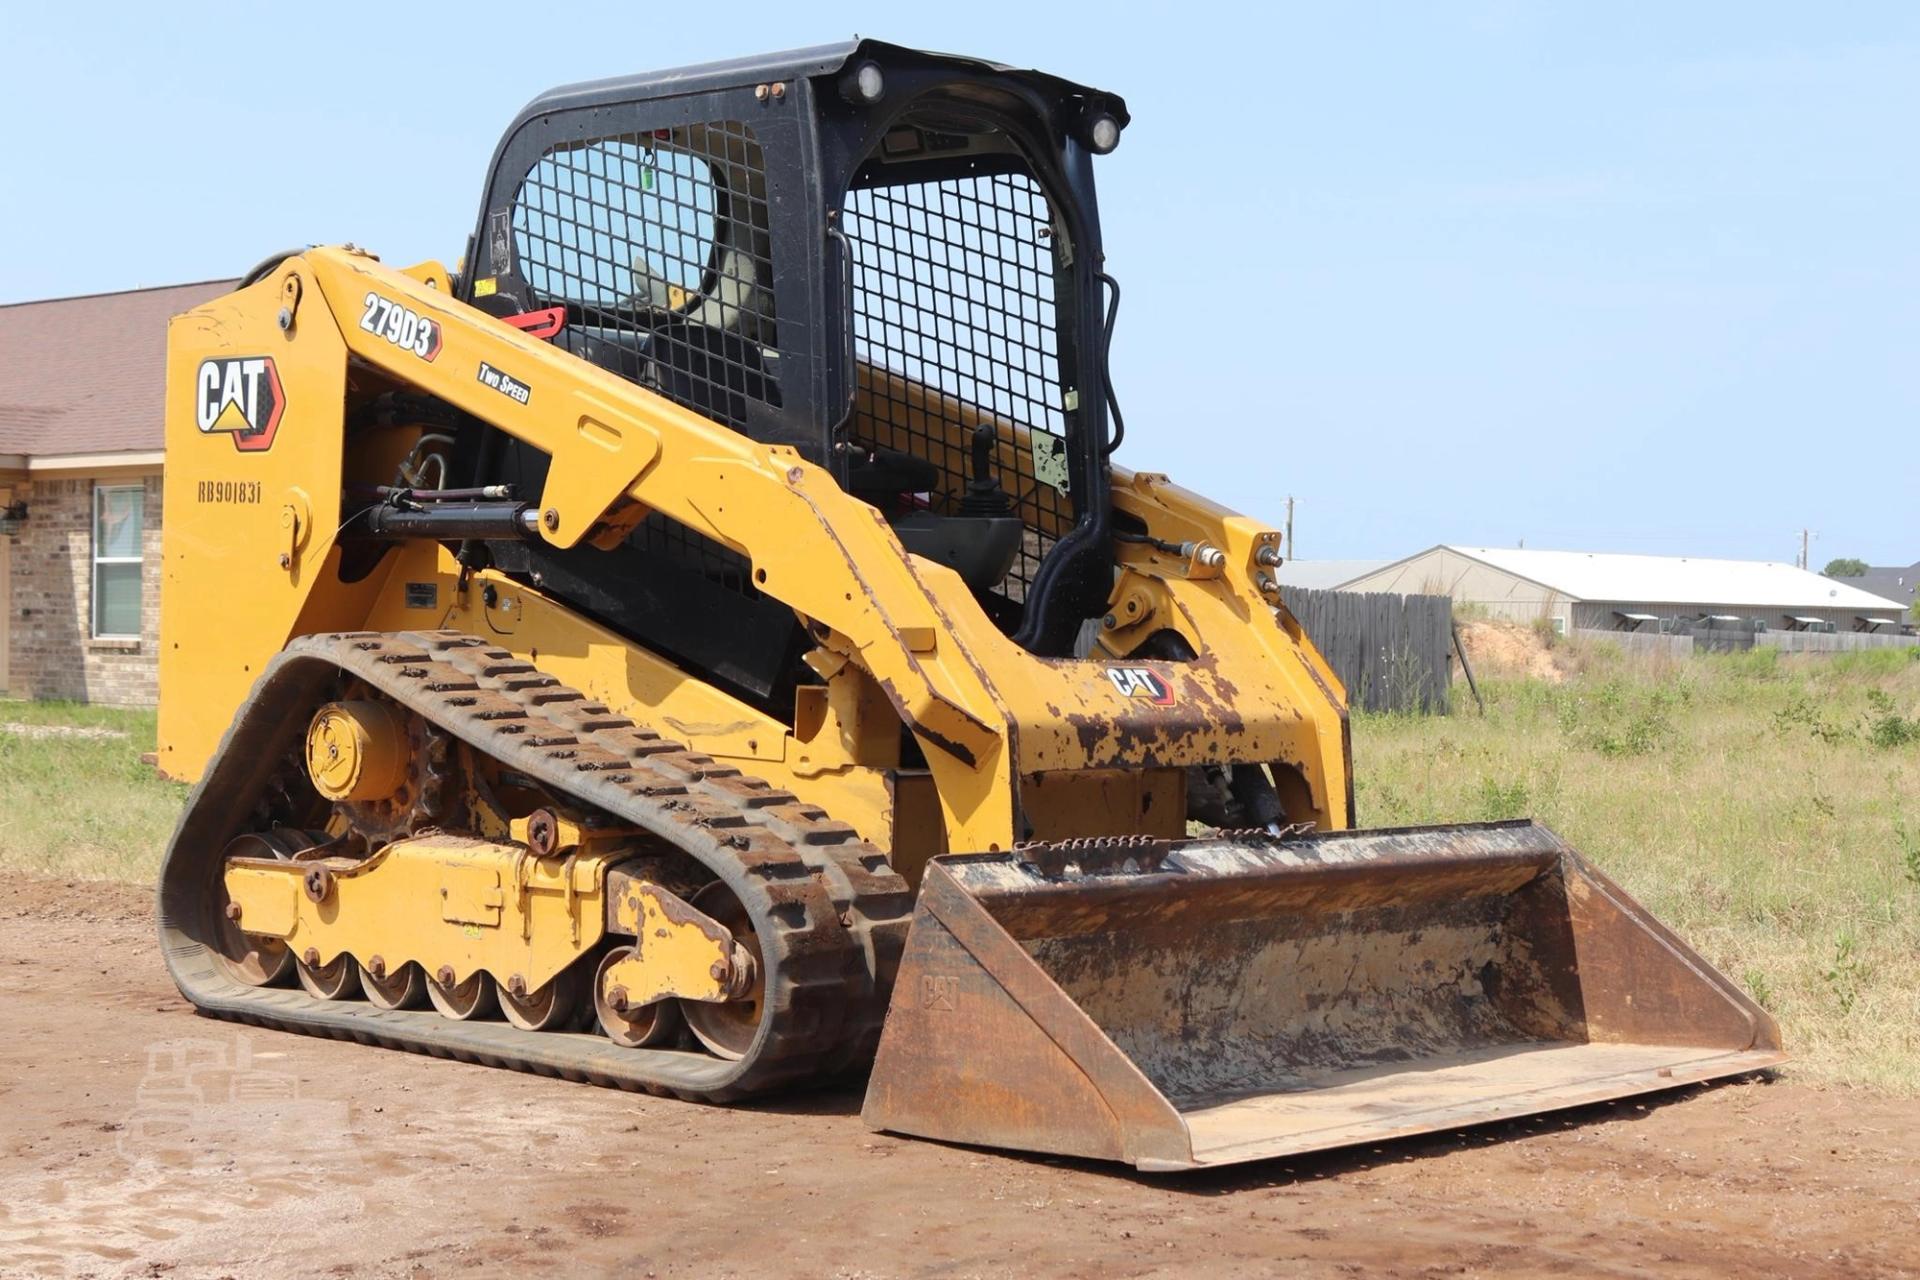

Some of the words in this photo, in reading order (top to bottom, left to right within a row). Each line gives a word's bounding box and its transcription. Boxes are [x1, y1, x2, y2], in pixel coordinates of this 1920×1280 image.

[360, 293, 431, 357] 279D3
[198, 360, 264, 431] CAT
[1106, 668, 1160, 697] CAT
[921, 975, 960, 1010] CAT
